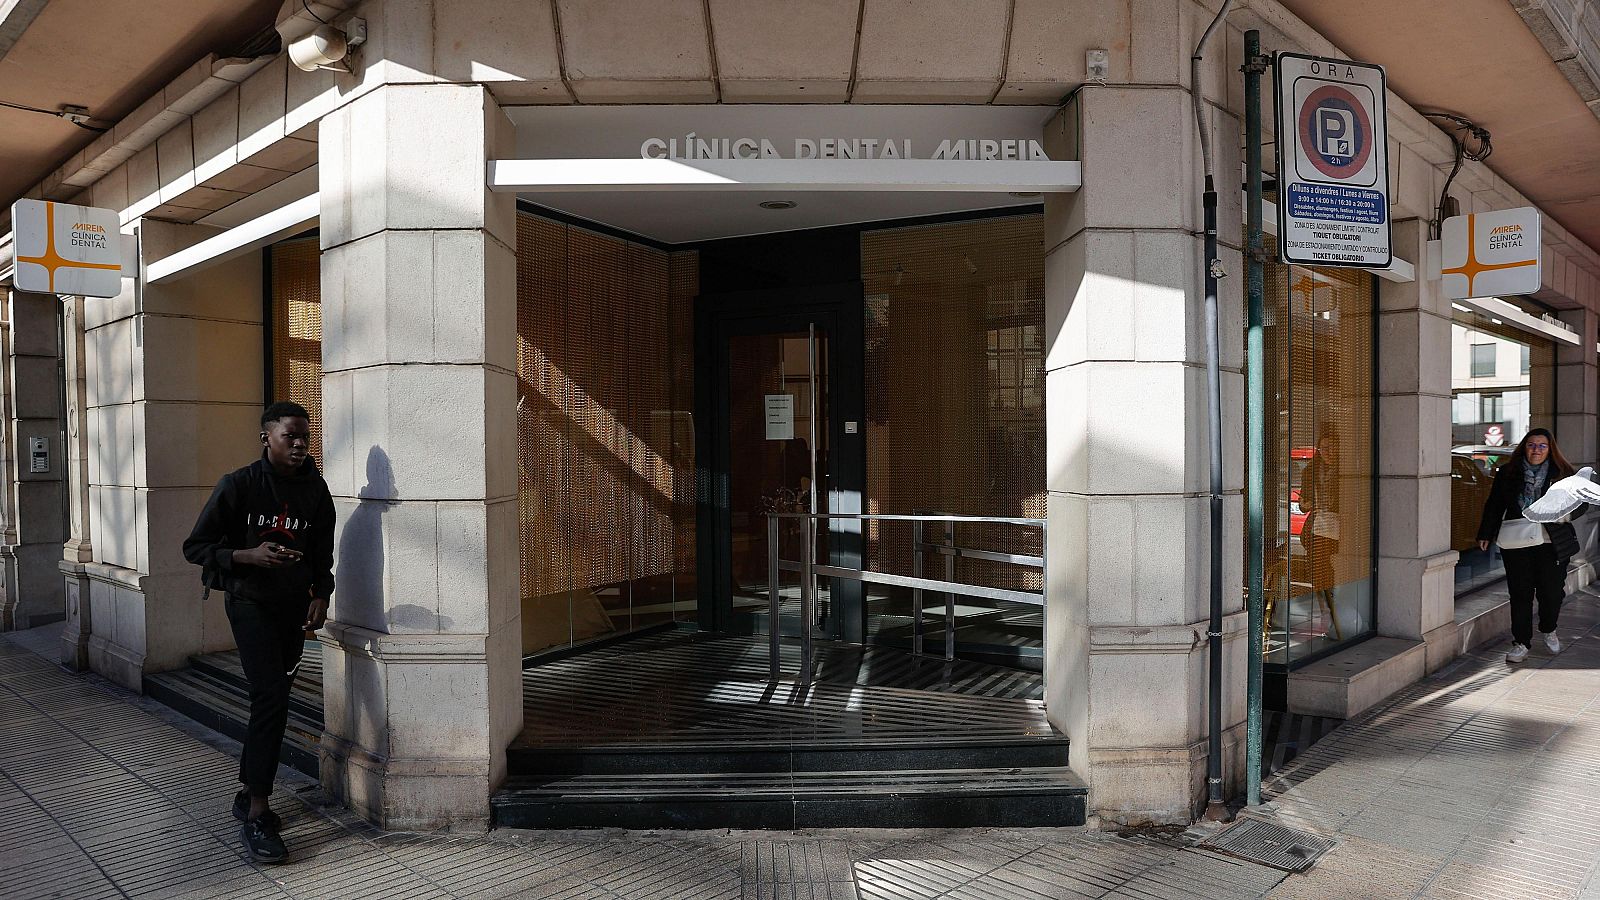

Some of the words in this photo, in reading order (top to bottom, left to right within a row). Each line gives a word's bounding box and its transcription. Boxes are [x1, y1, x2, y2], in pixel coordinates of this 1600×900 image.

[1311, 61, 1354, 78] ORA
[1320, 110, 1347, 153] P
[640, 131, 779, 160] CLÍNICA
[931, 138, 1051, 161] MIREIA
[1314, 185, 1338, 196] divendres
[71, 222, 106, 233] MIREIA
[1490, 224, 1523, 234] MIREIA
[1312, 231, 1332, 239] TIQUET
[1490, 233, 1523, 243] CLÍNICA
[71, 239, 106, 249] DENTAL
[1490, 240, 1523, 250] DENTAL
